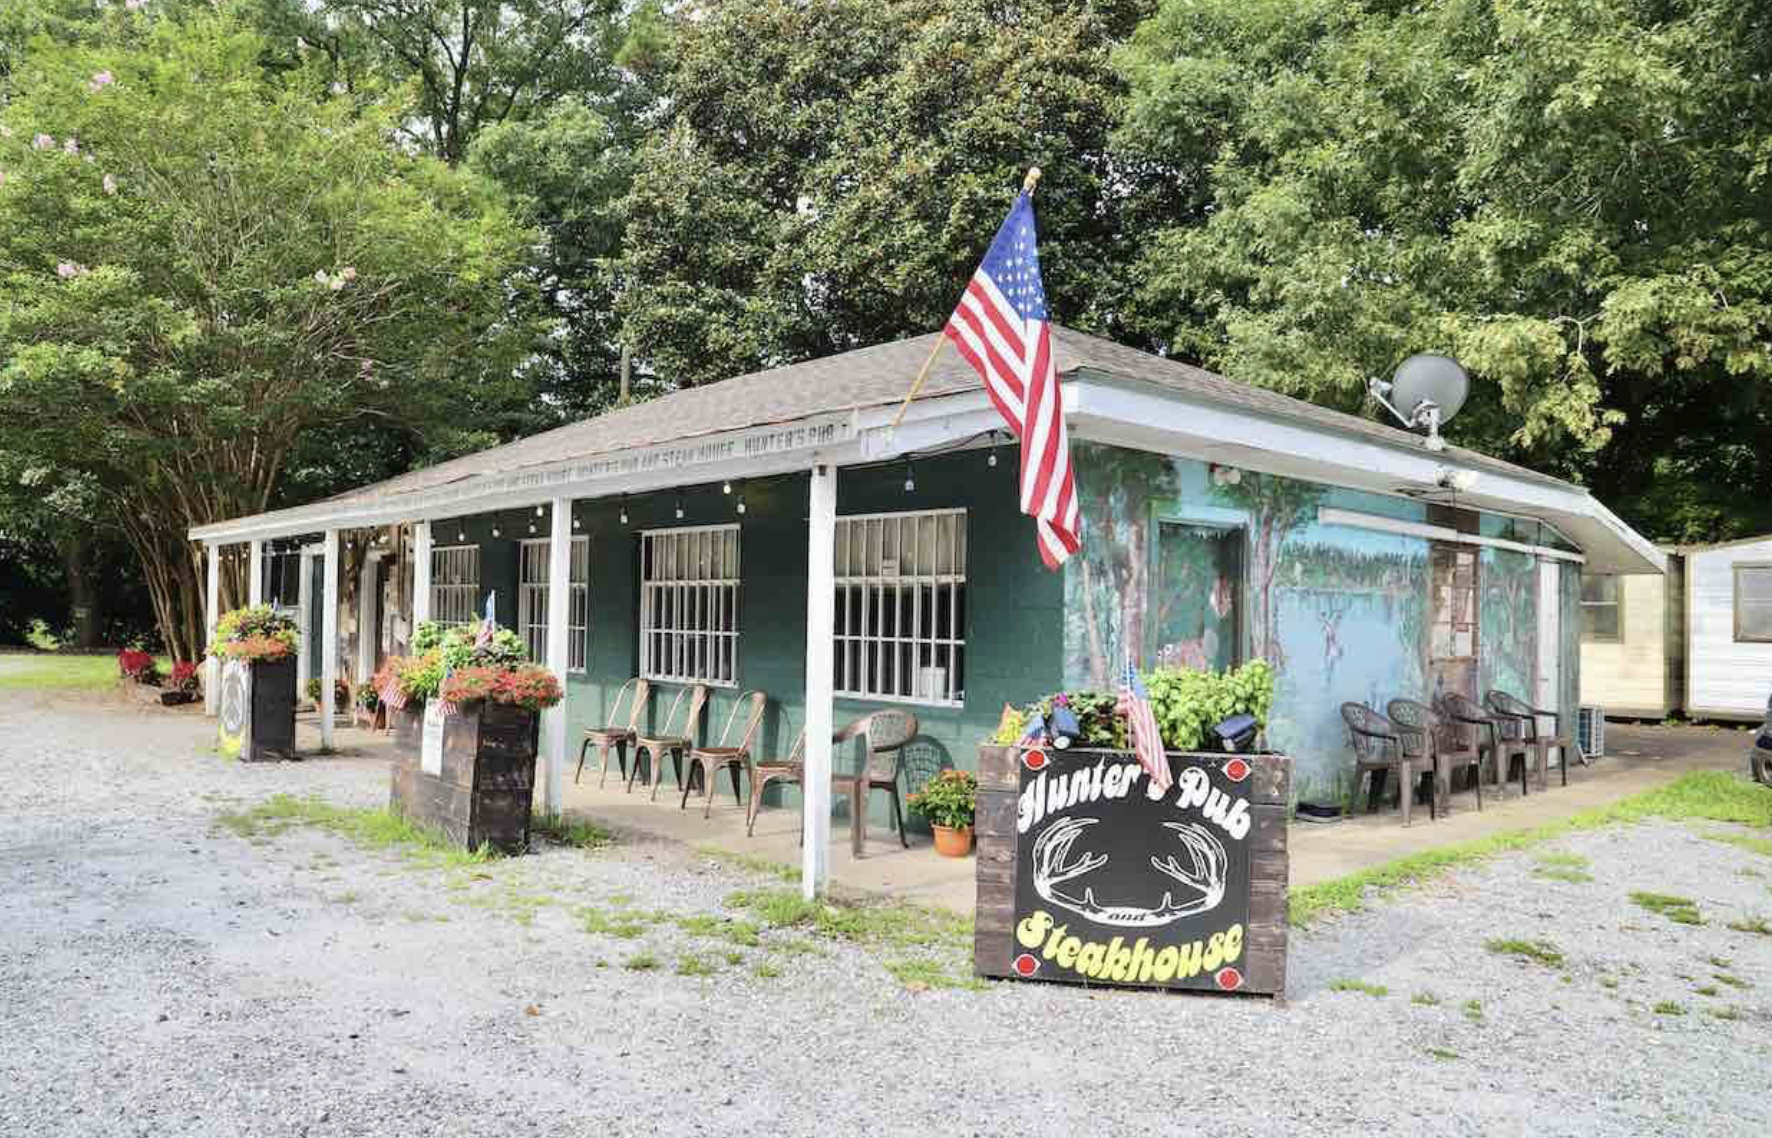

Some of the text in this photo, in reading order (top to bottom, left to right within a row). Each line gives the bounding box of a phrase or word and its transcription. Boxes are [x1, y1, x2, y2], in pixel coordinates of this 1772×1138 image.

[1017, 756, 1252, 840] Hunters Pub
[1016, 910, 1243, 982] Steakhouse
[1107, 912, 1147, 922] and
